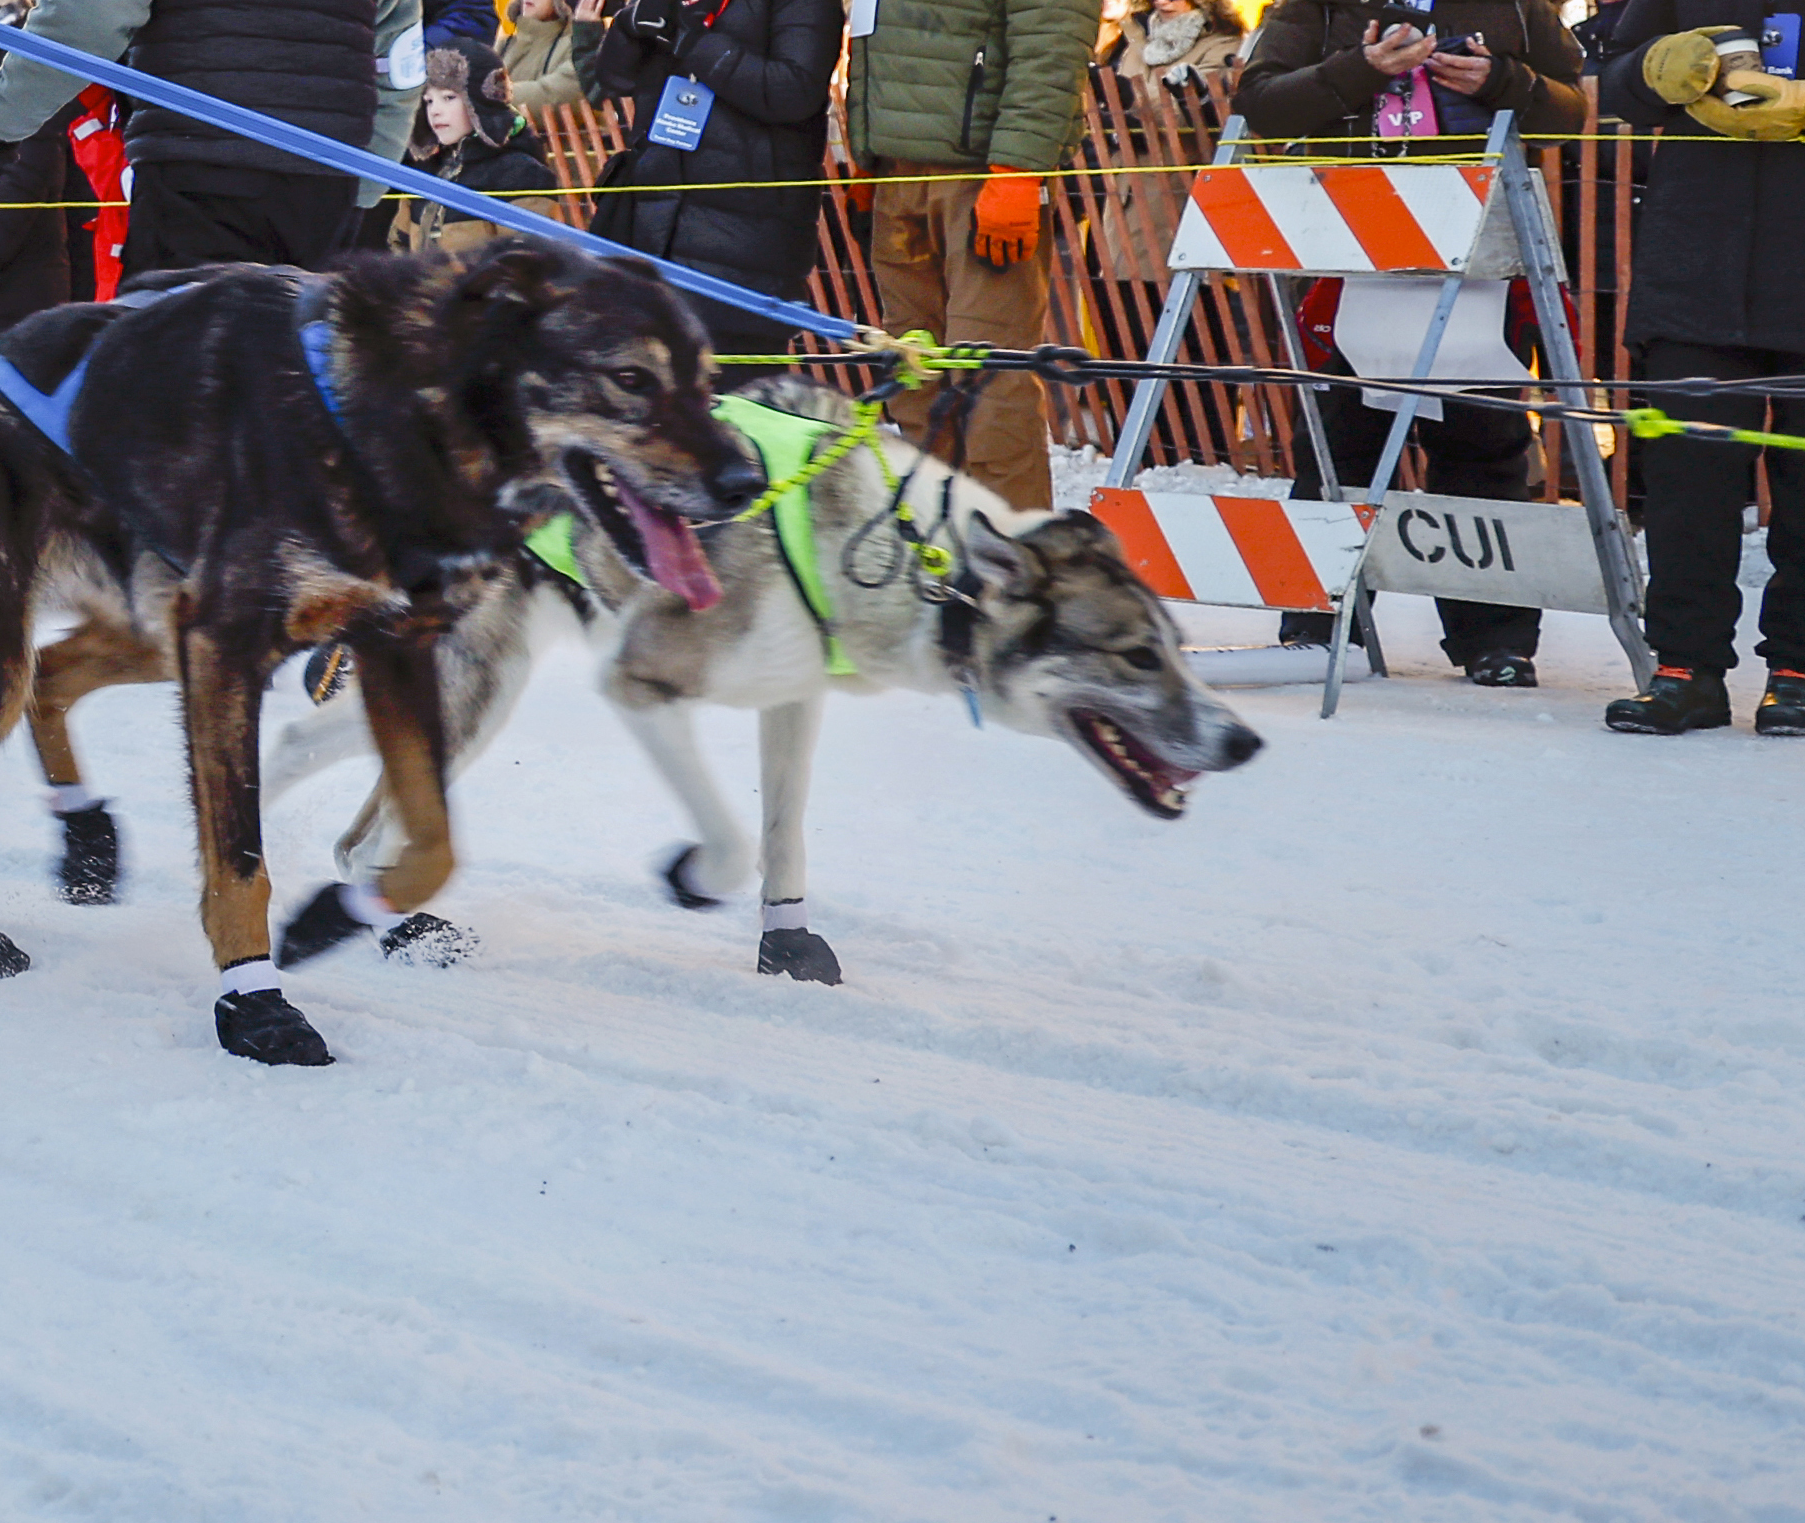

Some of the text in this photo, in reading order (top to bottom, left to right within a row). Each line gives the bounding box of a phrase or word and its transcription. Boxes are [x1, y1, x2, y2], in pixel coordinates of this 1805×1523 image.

[1769, 65, 1793, 76] Bank
[1388, 110, 1424, 127] VP
[1397, 508, 1515, 571] CUI
